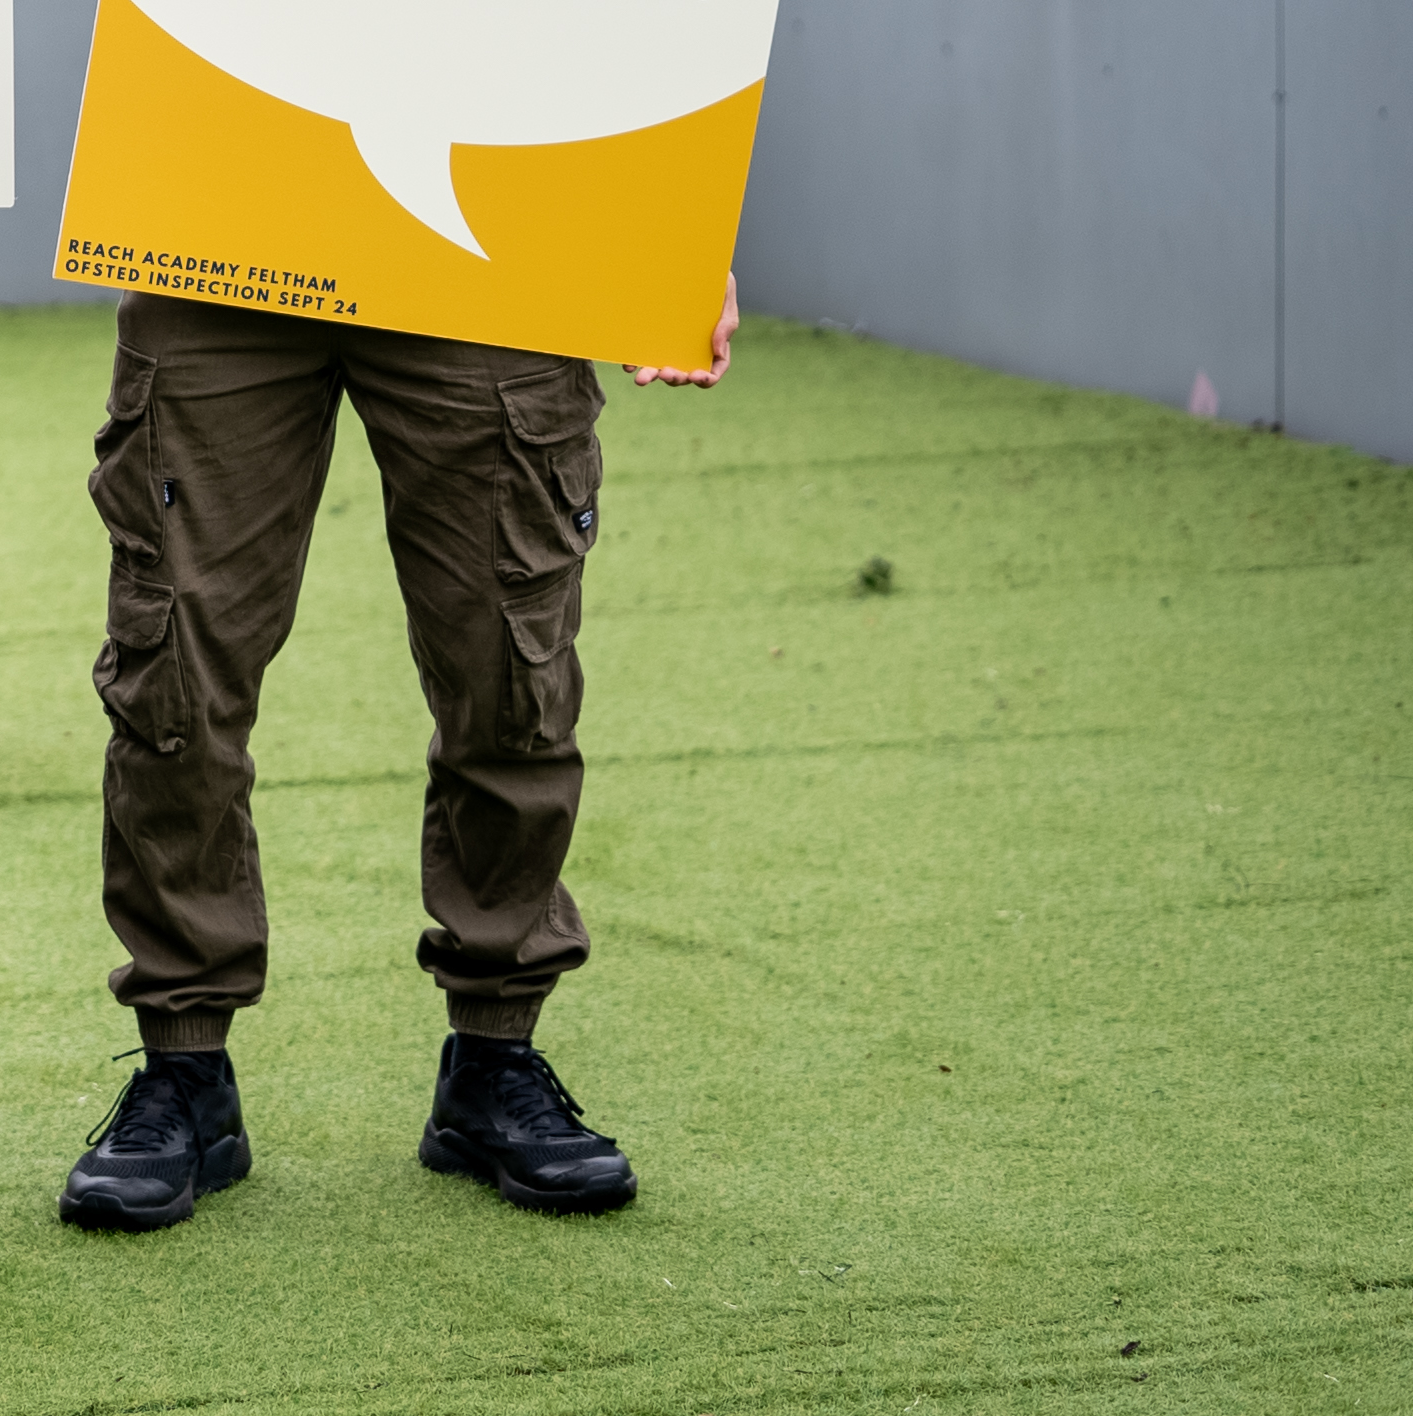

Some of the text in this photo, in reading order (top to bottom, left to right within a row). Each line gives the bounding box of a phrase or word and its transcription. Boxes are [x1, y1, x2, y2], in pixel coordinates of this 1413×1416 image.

[65, 258, 357, 316] OFSTED INSPECTION SEPT 24
[68, 238, 336, 293] REACH ACADEMY FELTHAM
